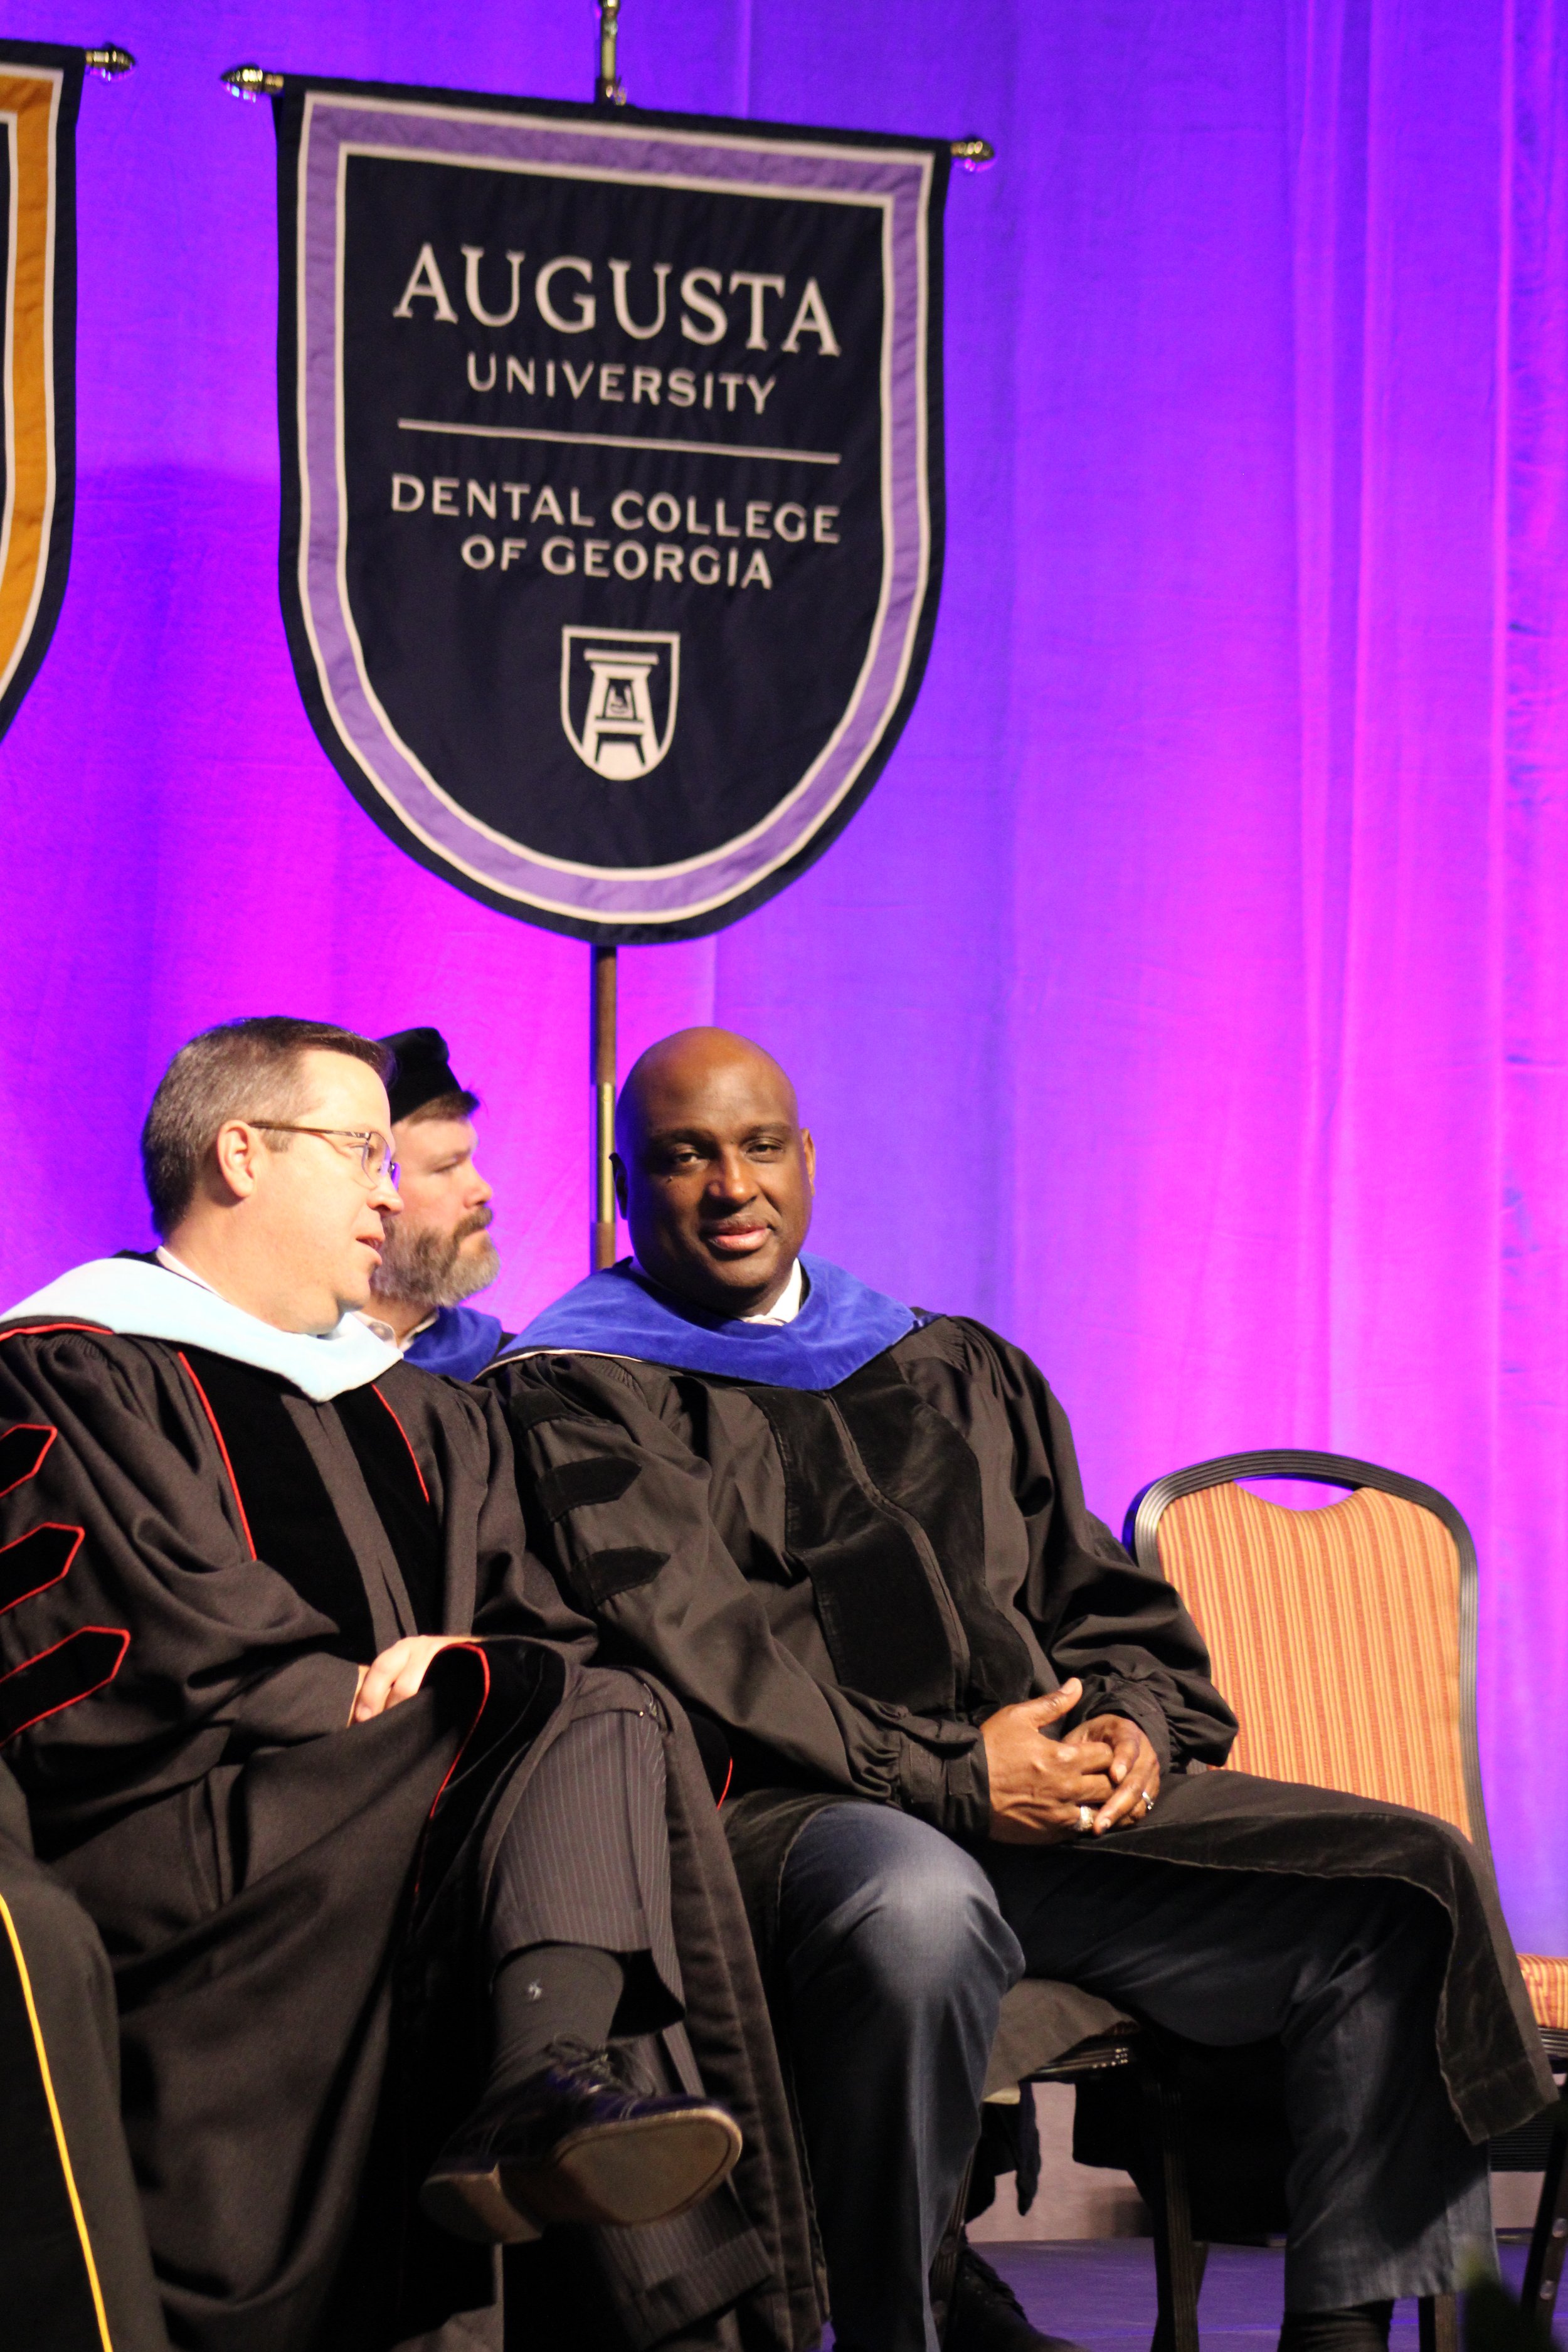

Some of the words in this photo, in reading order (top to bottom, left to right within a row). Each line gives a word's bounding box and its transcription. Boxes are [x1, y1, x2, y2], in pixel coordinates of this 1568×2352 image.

[393, 243, 839, 356] AUGUSTA
[467, 352, 775, 414] UNIVERSITY
[391, 474, 594, 527] DENTAL
[611, 490, 839, 544] COLLEGE
[461, 535, 527, 571] OF
[541, 536, 771, 590] GEORGIA
